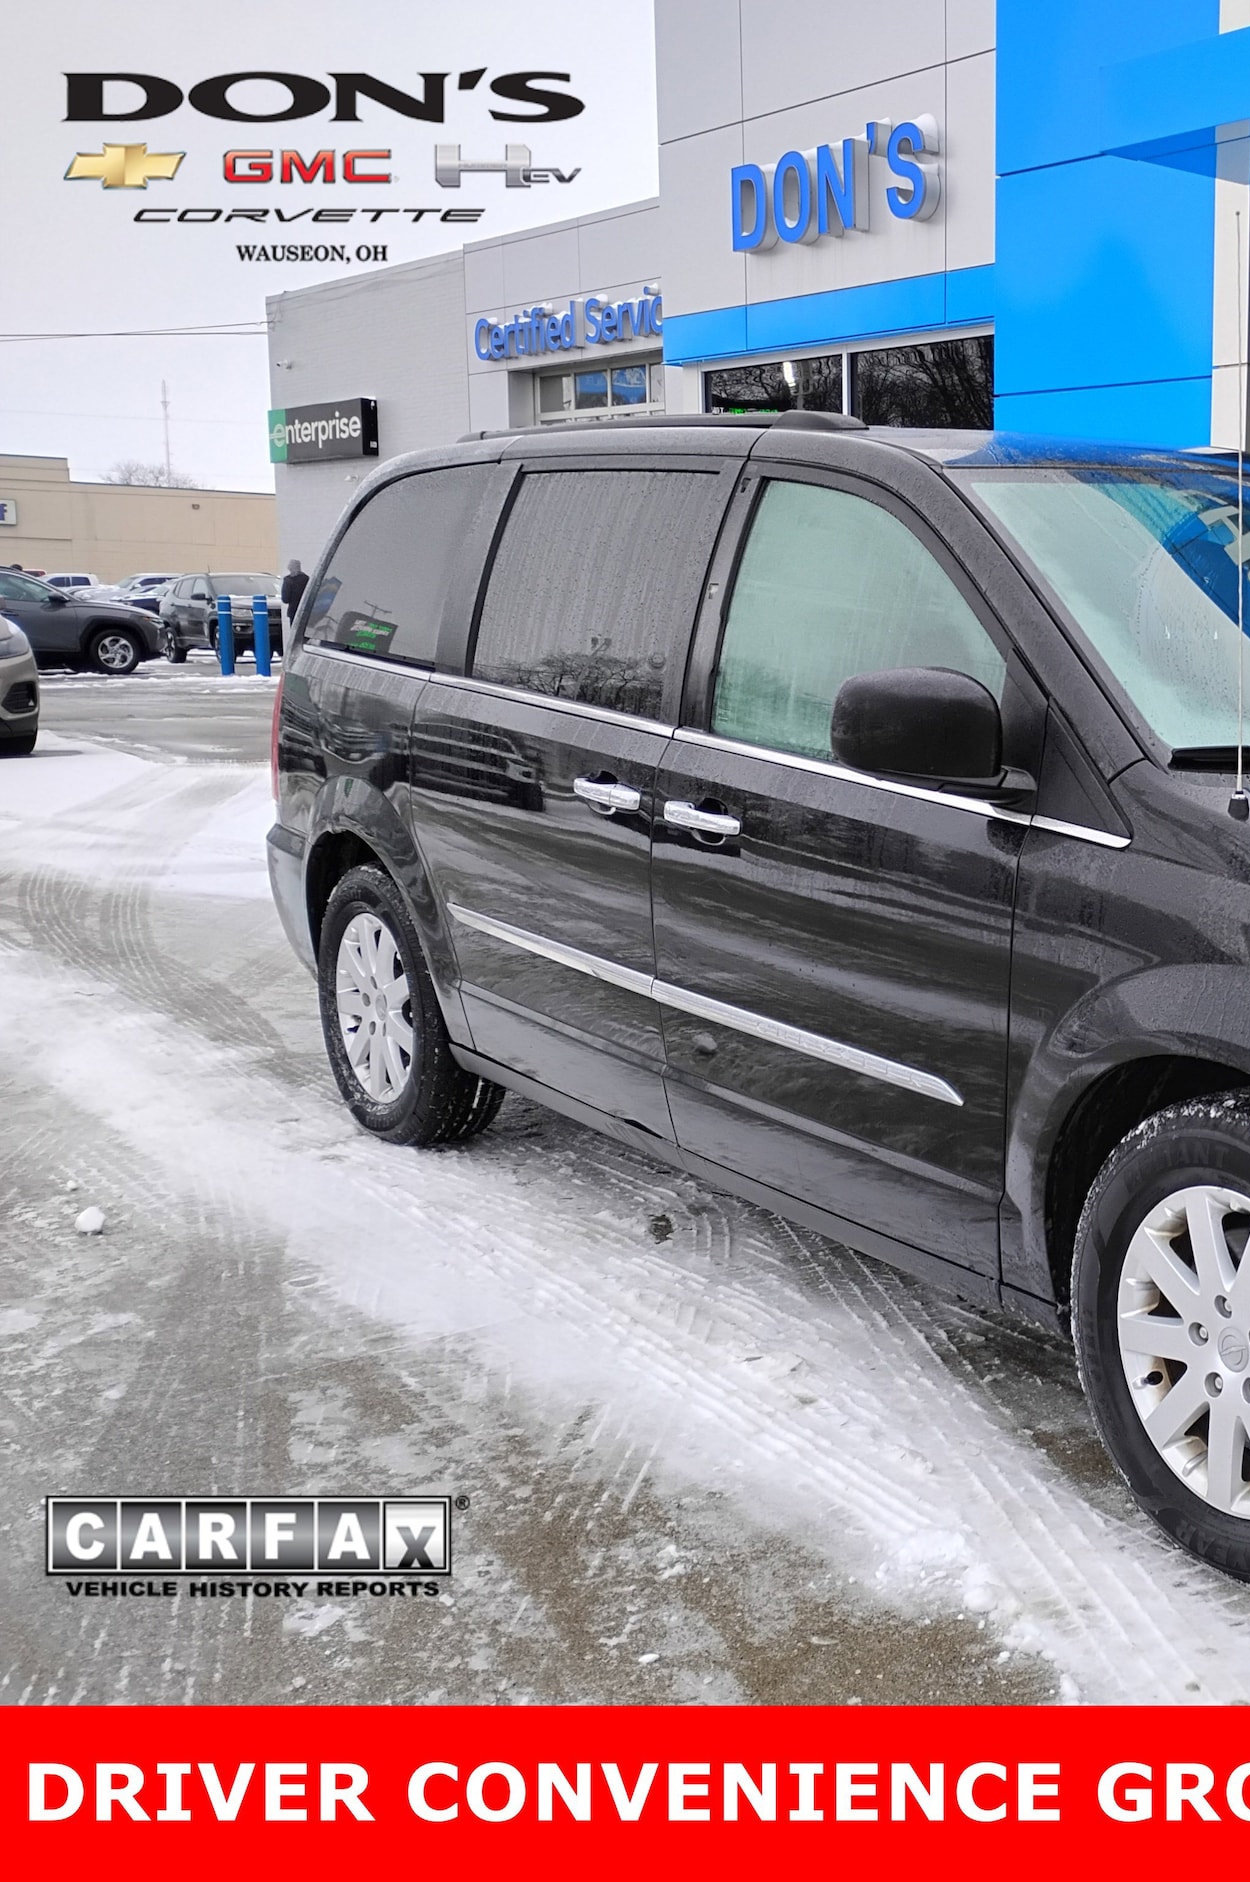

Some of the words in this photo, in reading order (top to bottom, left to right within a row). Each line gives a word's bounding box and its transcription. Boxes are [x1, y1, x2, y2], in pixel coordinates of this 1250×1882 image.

[731, 119, 940, 252] DON'S
[475, 300, 577, 361] Certified
[270, 411, 362, 449] enterprise
